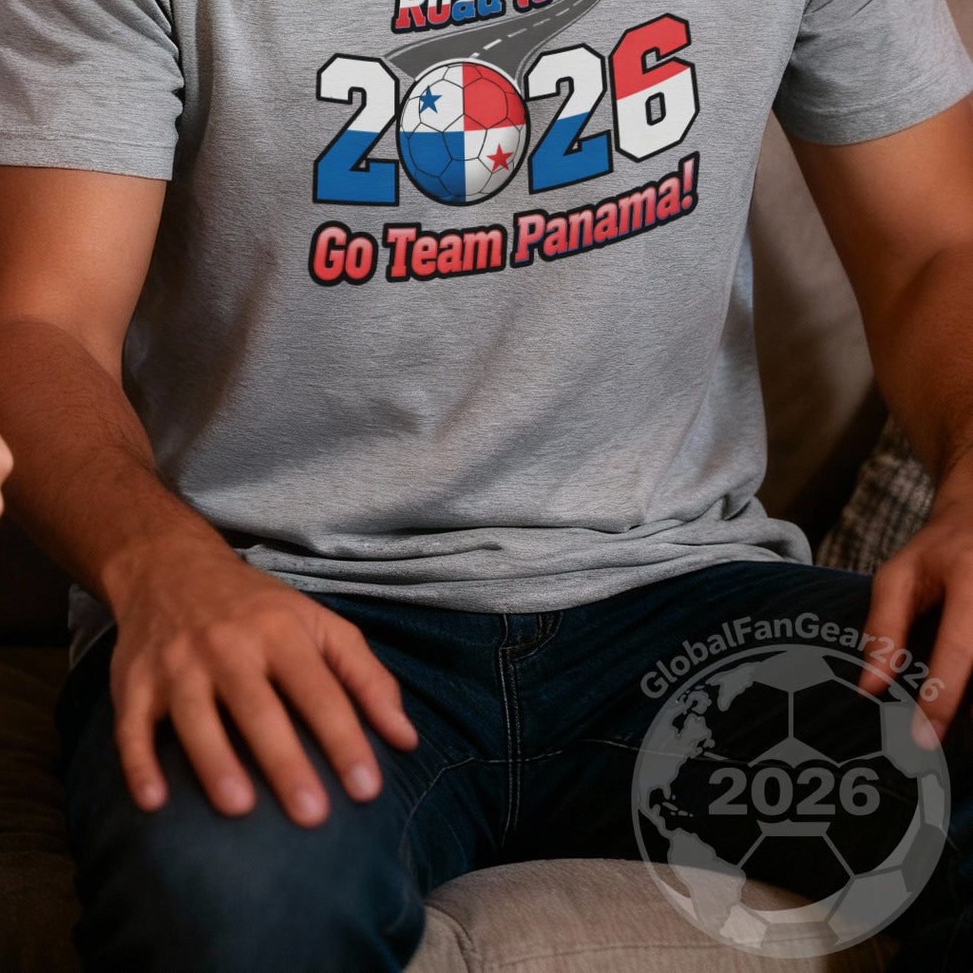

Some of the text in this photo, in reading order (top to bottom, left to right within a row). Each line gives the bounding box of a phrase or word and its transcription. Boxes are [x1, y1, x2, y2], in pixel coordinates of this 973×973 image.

[308, 151, 700, 286] Go Team Panama!
